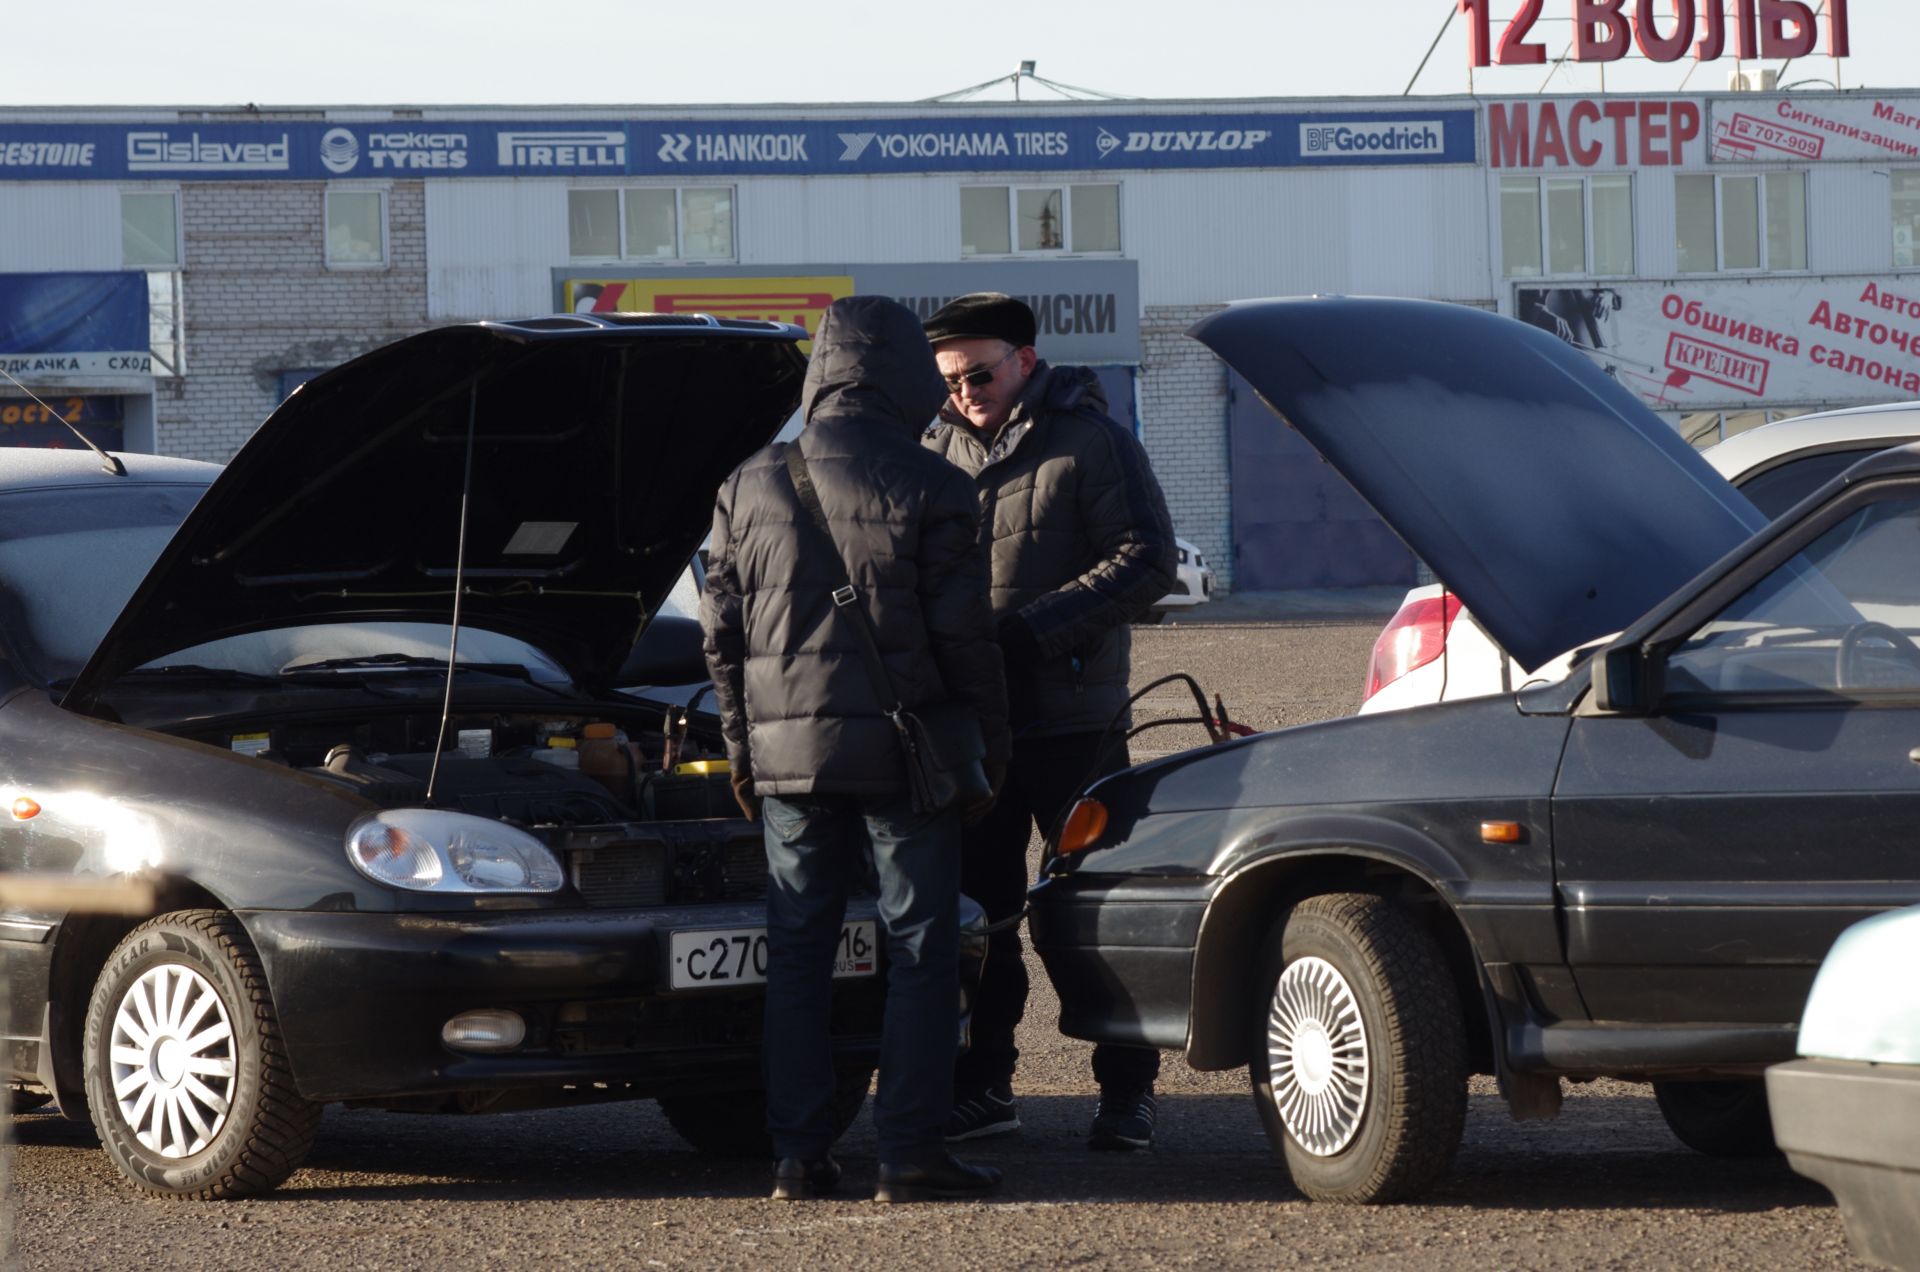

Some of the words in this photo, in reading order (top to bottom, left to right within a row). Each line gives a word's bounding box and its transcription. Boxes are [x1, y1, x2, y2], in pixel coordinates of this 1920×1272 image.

[1459, 0, 1546, 67] 12
[1123, 130, 1268, 152] DUNLOP
[1306, 126, 1438, 151] BFGoodrich
[1488, 100, 1700, 168] МАСТЕР
[1755, 125, 1818, 155] 707-909
[1777, 101, 1918, 157] Сигнализации
[127, 132, 289, 163] Gislaved
[369, 150, 468, 169] TYRES
[498, 131, 627, 166] PIRELLI
[697, 134, 808, 162] HANKOOK
[877, 133, 1010, 158] YOKOHAMA
[1014, 132, 1069, 156] TIRES
[1016, 292, 1116, 336] ИСКИ
[1660, 293, 1800, 357] Обшивка
[1809, 344, 1920, 394] салона
[108, 356, 152, 372] СХОД
[1674, 341, 1761, 386] КРЕДИТ
[0, 404, 54, 424] ост
[63, 396, 85, 423] 2
